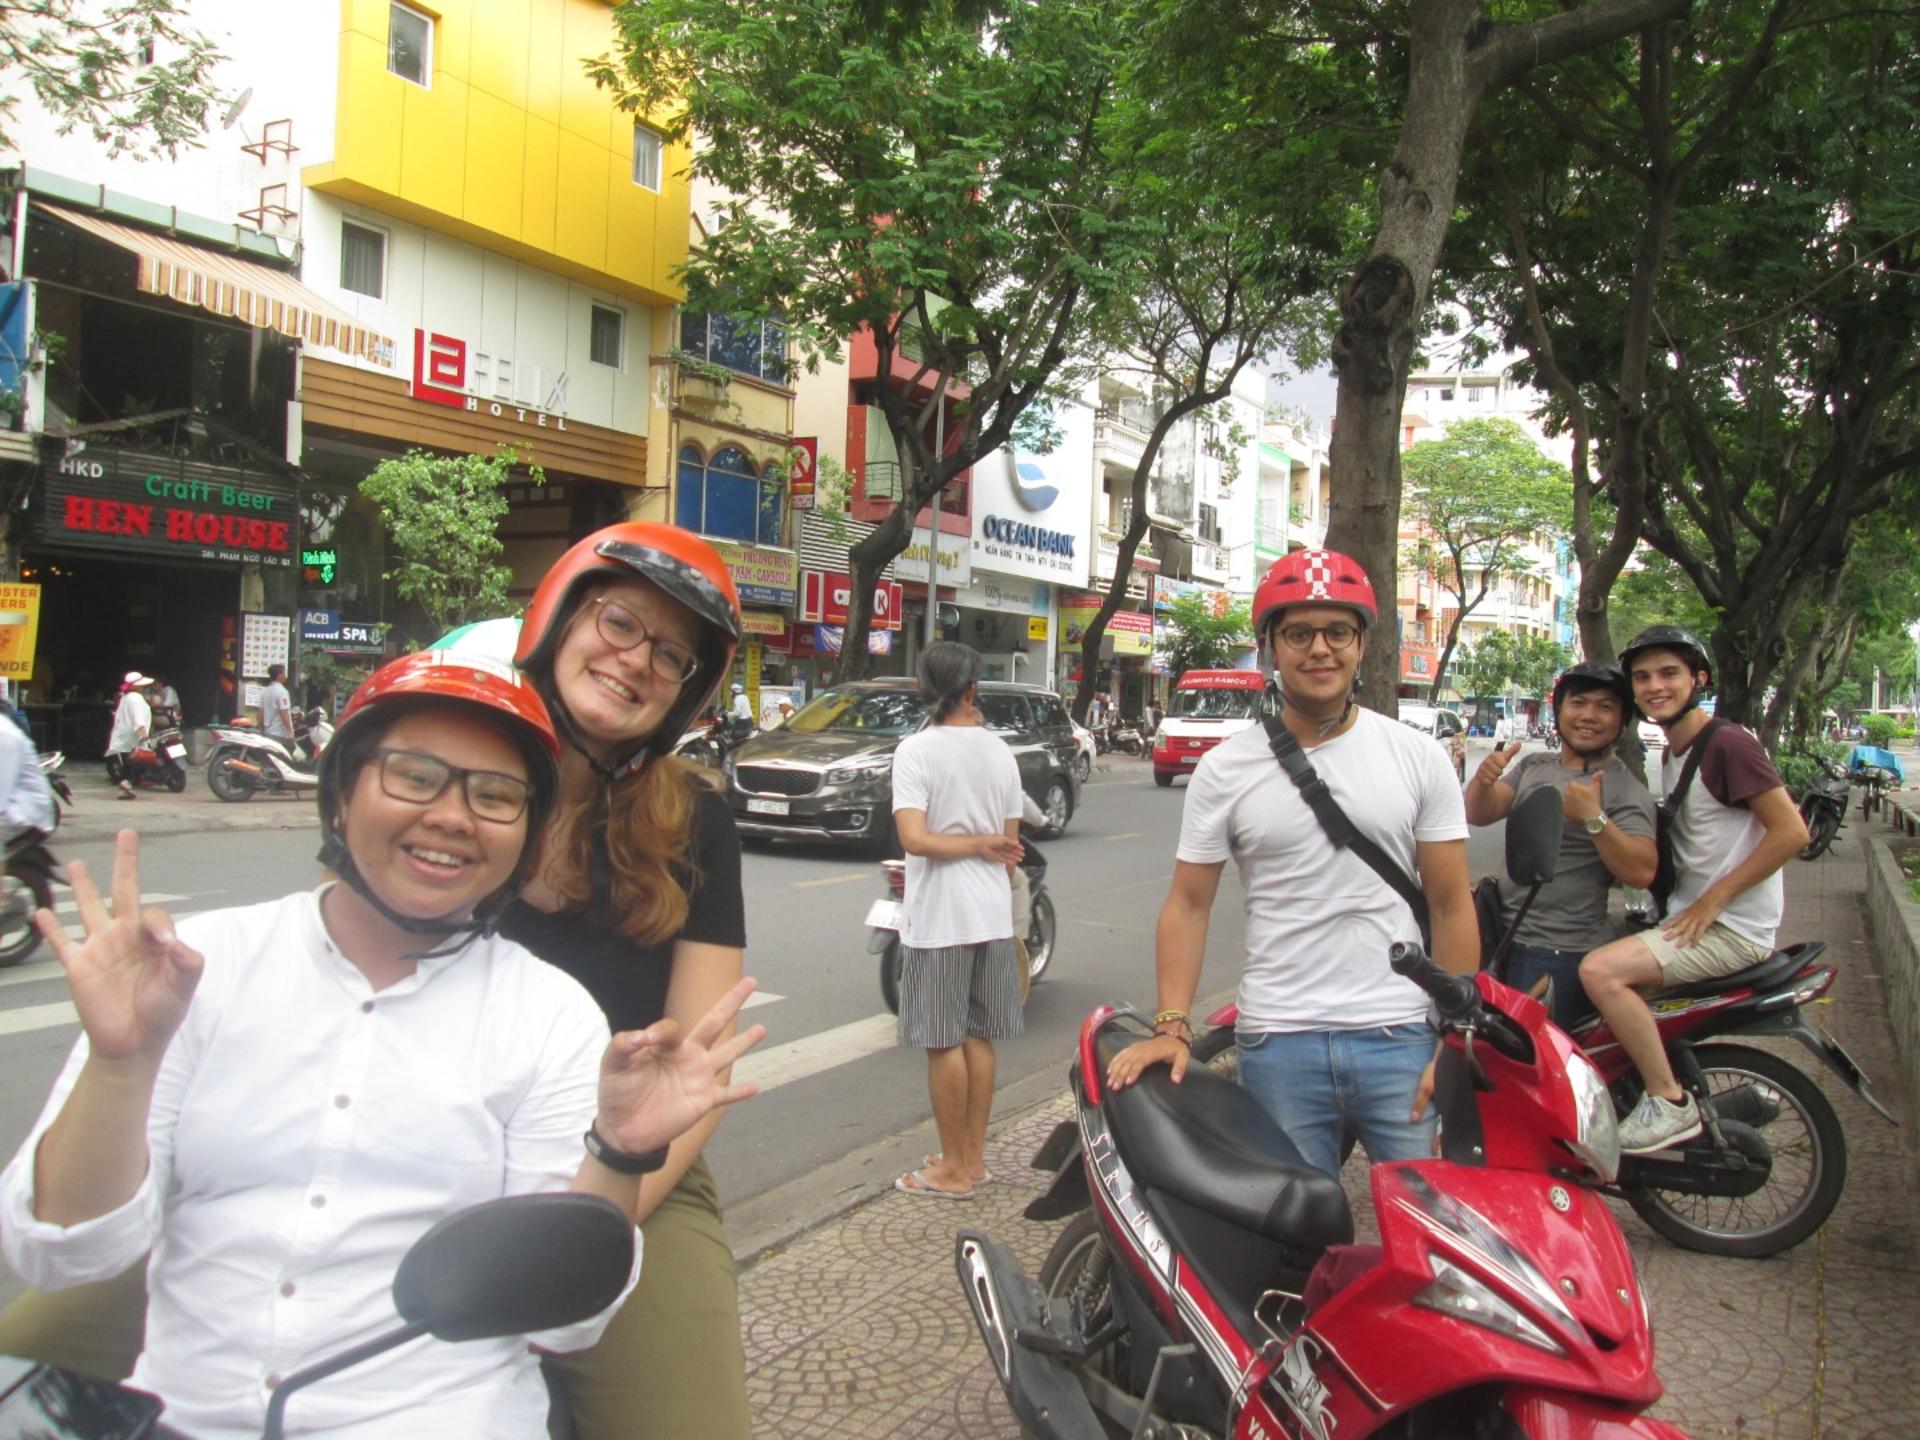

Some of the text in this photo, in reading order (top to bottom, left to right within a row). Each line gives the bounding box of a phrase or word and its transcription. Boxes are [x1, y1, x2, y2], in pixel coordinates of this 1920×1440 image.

[466, 397, 569, 432] HOTEL
[60, 459, 104, 479] HKD
[145, 473, 276, 511] Craft Beer
[64, 495, 290, 552] HEN HOUSE
[984, 514, 1076, 559] OCEAN BANK
[0, 587, 38, 598] STER
[305, 612, 330, 625] ACB
[343, 627, 368, 642] SPA
